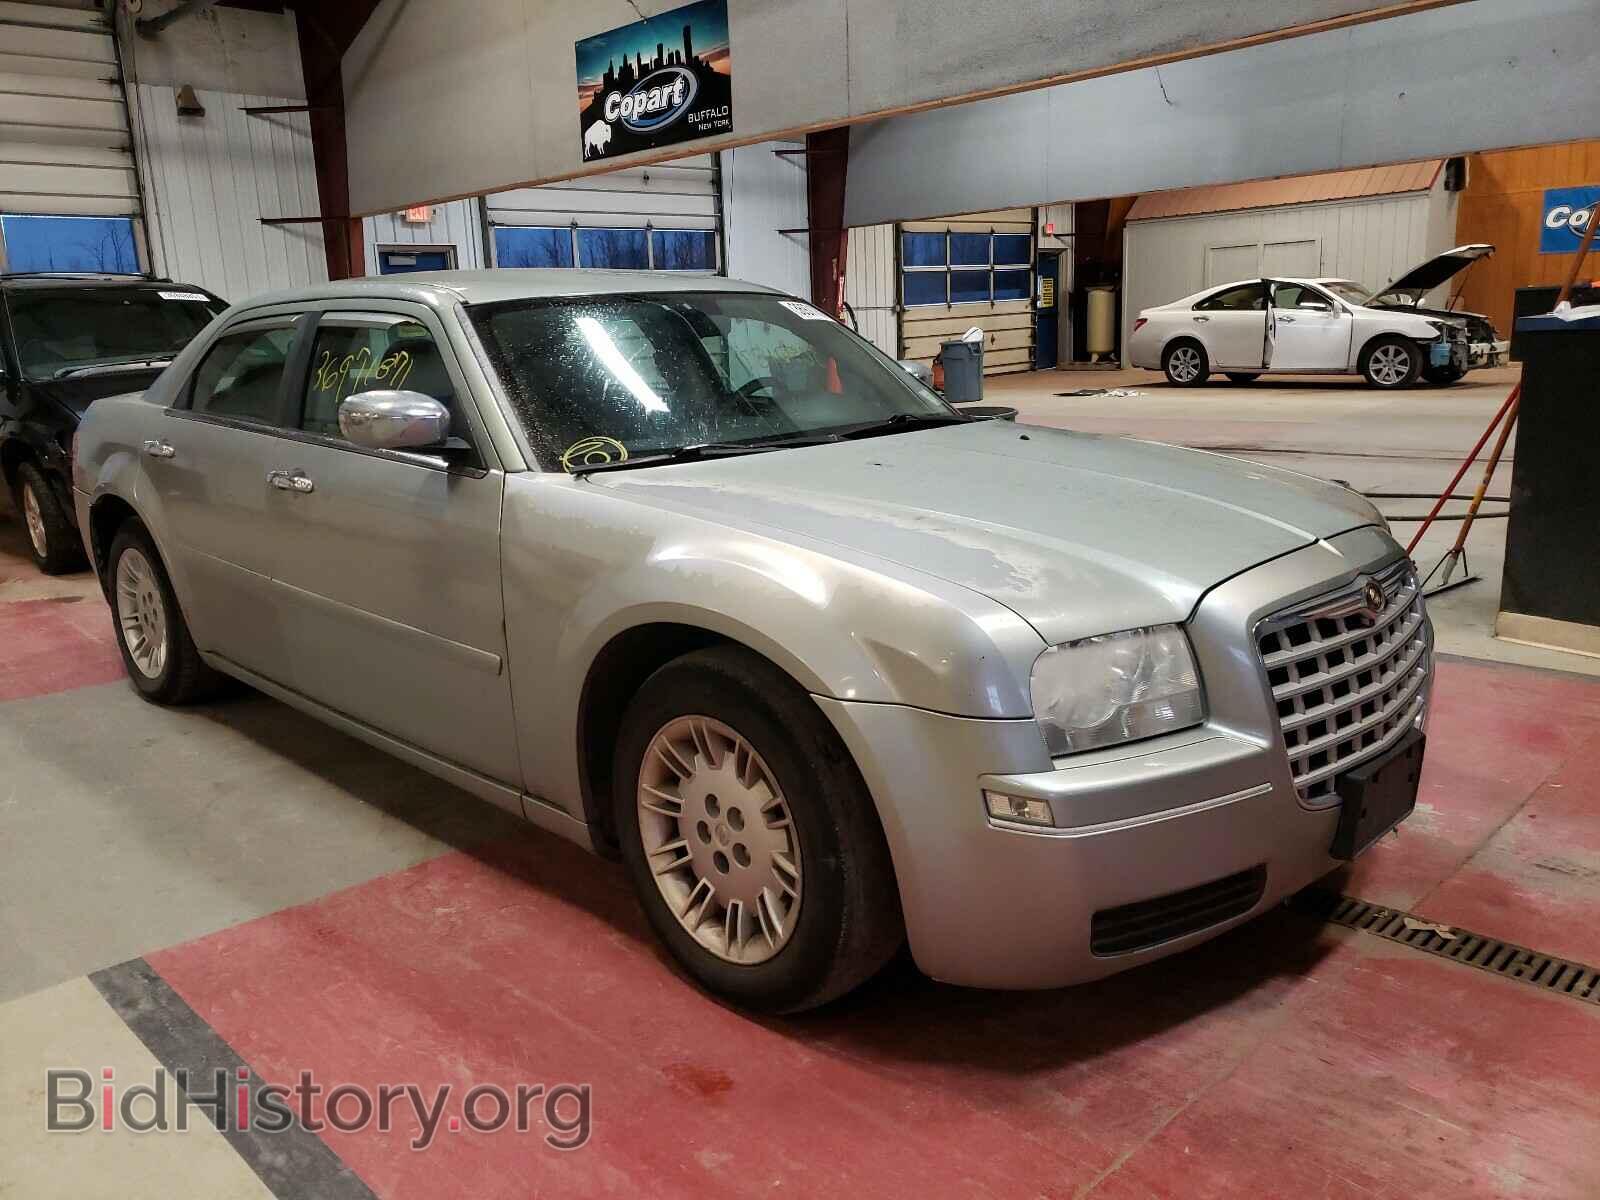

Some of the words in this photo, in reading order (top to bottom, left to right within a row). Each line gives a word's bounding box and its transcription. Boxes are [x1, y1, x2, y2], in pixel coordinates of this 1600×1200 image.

[604, 73, 685, 122] Copart
[688, 105, 729, 123] BUFFALO
[698, 122, 711, 131] NEW
[713, 119, 730, 128] YORK
